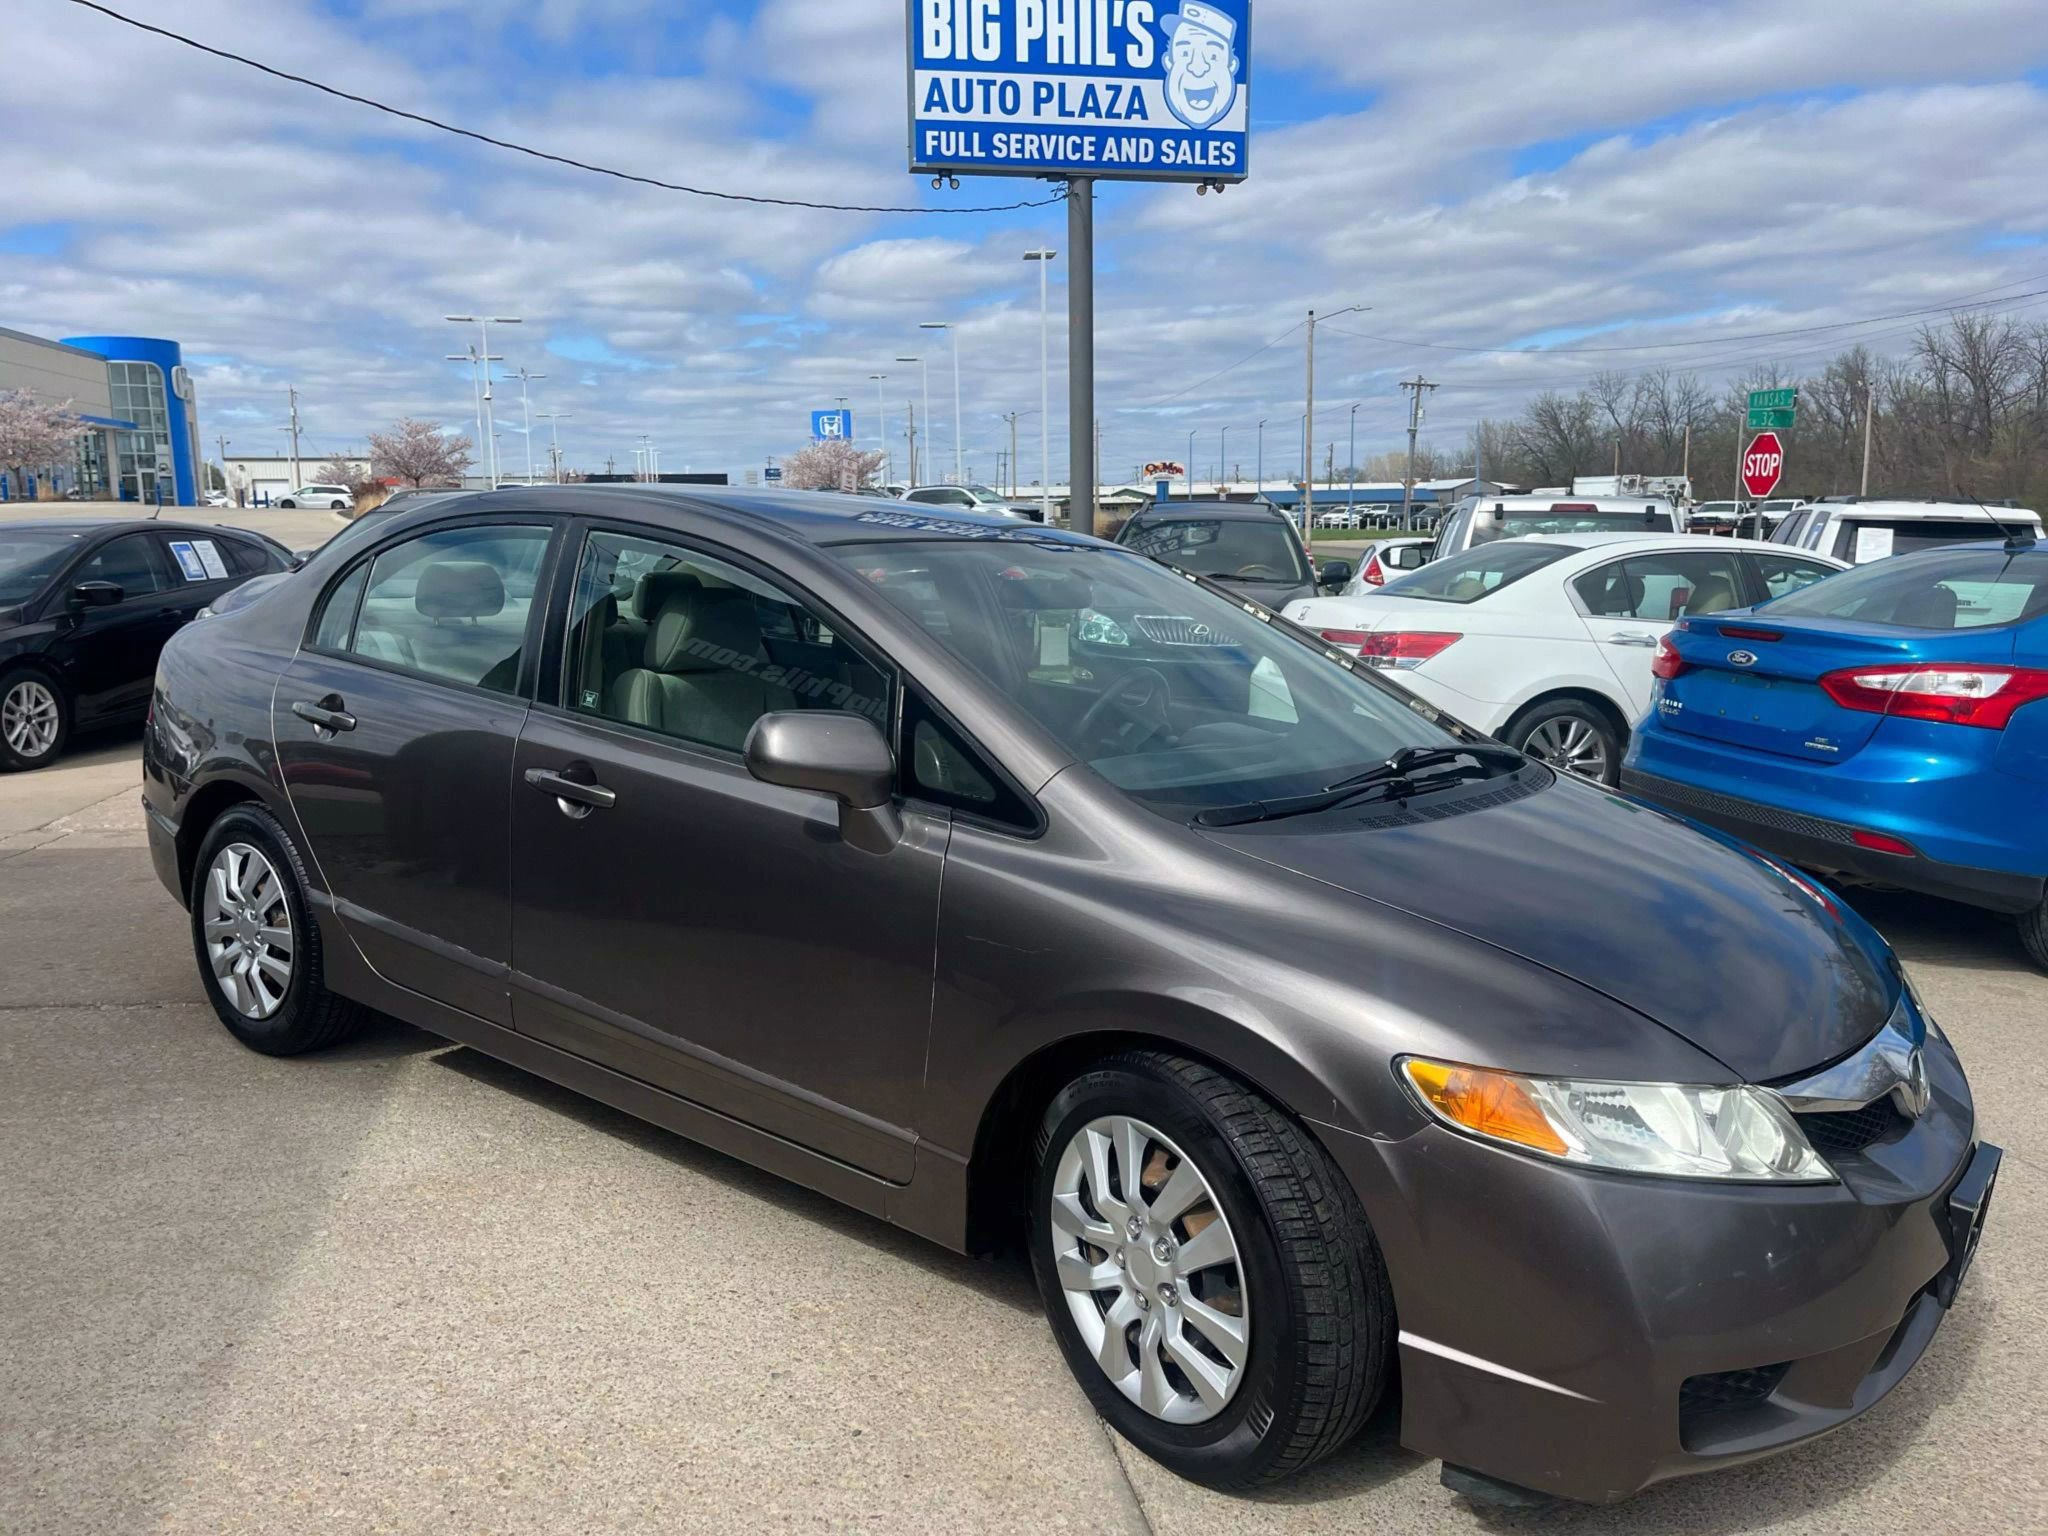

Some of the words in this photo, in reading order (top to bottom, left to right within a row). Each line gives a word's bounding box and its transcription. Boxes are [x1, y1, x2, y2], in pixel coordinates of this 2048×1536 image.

[922, 0, 1001, 61] BIG
[1016, 0, 1154, 69] PHIL'S
[923, 78, 1021, 116] AUTO
[1033, 81, 1149, 121] PLAZA
[925, 130, 986, 158] FULL
[992, 133, 1096, 162] SERVICE
[1102, 137, 1154, 163] AND
[1161, 139, 1236, 166] SALES
[1760, 411, 1775, 426] 32
[1745, 453, 1779, 477] STOP
